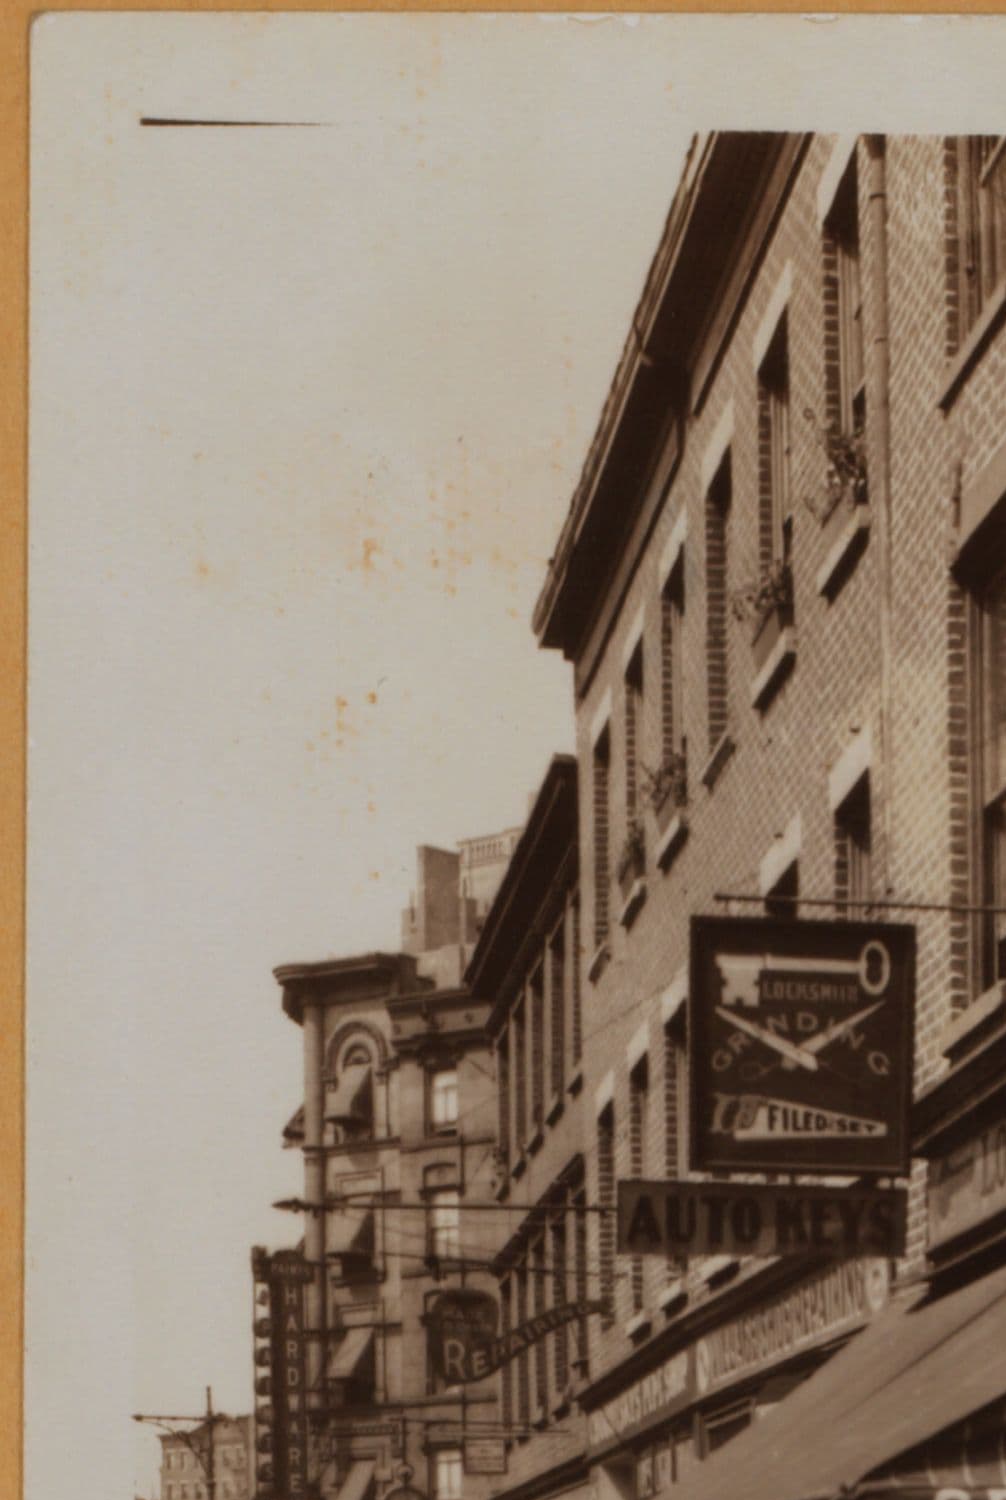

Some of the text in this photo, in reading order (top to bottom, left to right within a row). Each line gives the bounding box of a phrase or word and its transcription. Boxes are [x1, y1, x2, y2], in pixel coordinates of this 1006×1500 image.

[766, 1103, 827, 1133] FILED
[626, 1193, 899, 1246] AUTO KEYS
[284, 1286, 304, 1494] HARDWARE
